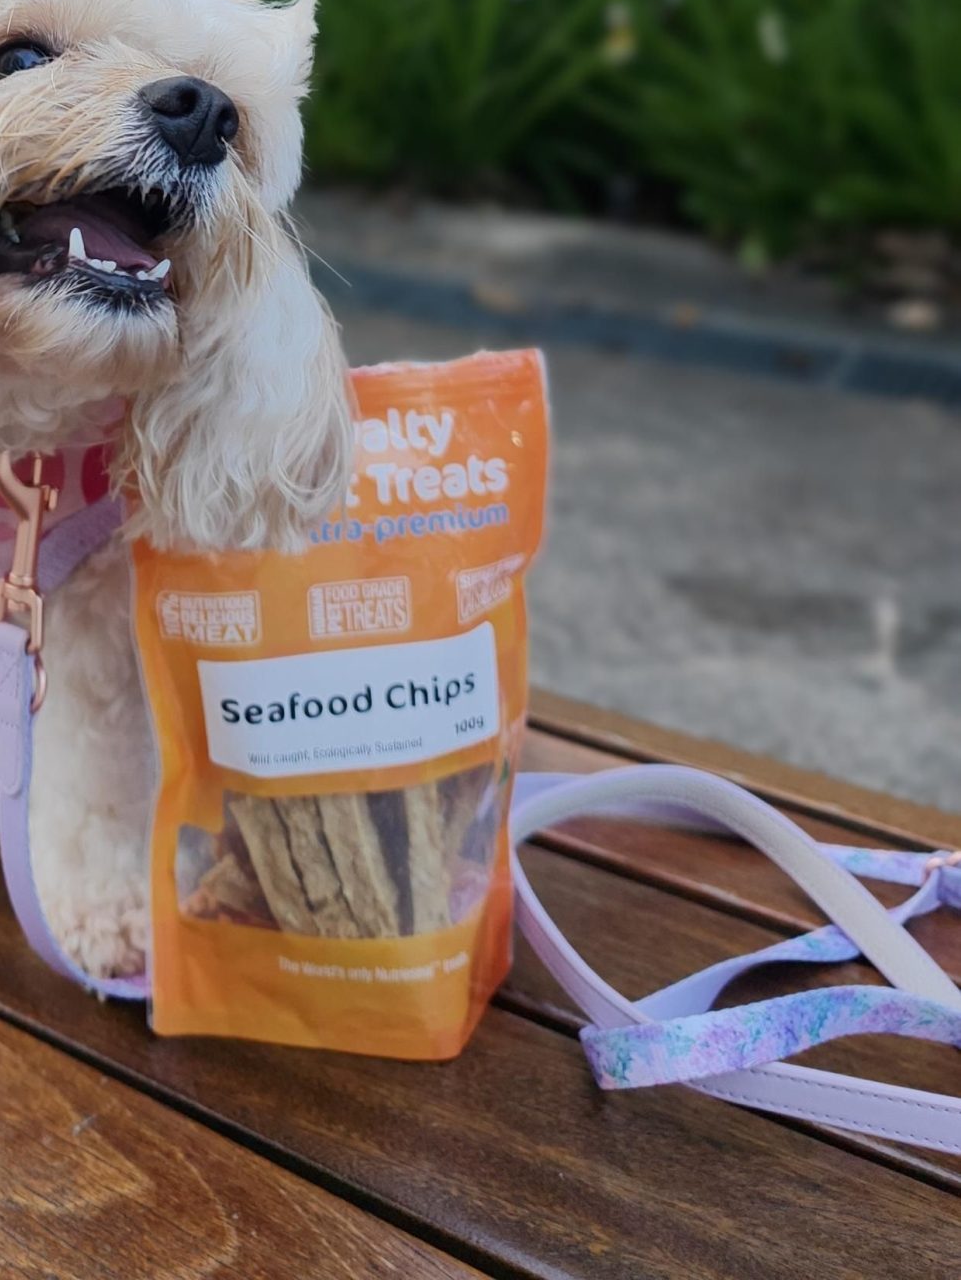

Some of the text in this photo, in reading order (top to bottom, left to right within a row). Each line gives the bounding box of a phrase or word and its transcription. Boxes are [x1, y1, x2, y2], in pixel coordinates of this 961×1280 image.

[353, 407, 454, 457] alty
[366, 454, 509, 505] Treats
[325, 584, 359, 602] FOOD
[340, 598, 408, 632] TREATS
[182, 624, 254, 642] MEAT
[220, 672, 476, 725] Seafood Chips
[454, 716, 485, 736] 100g
[374, 736, 424, 754] Sustained
